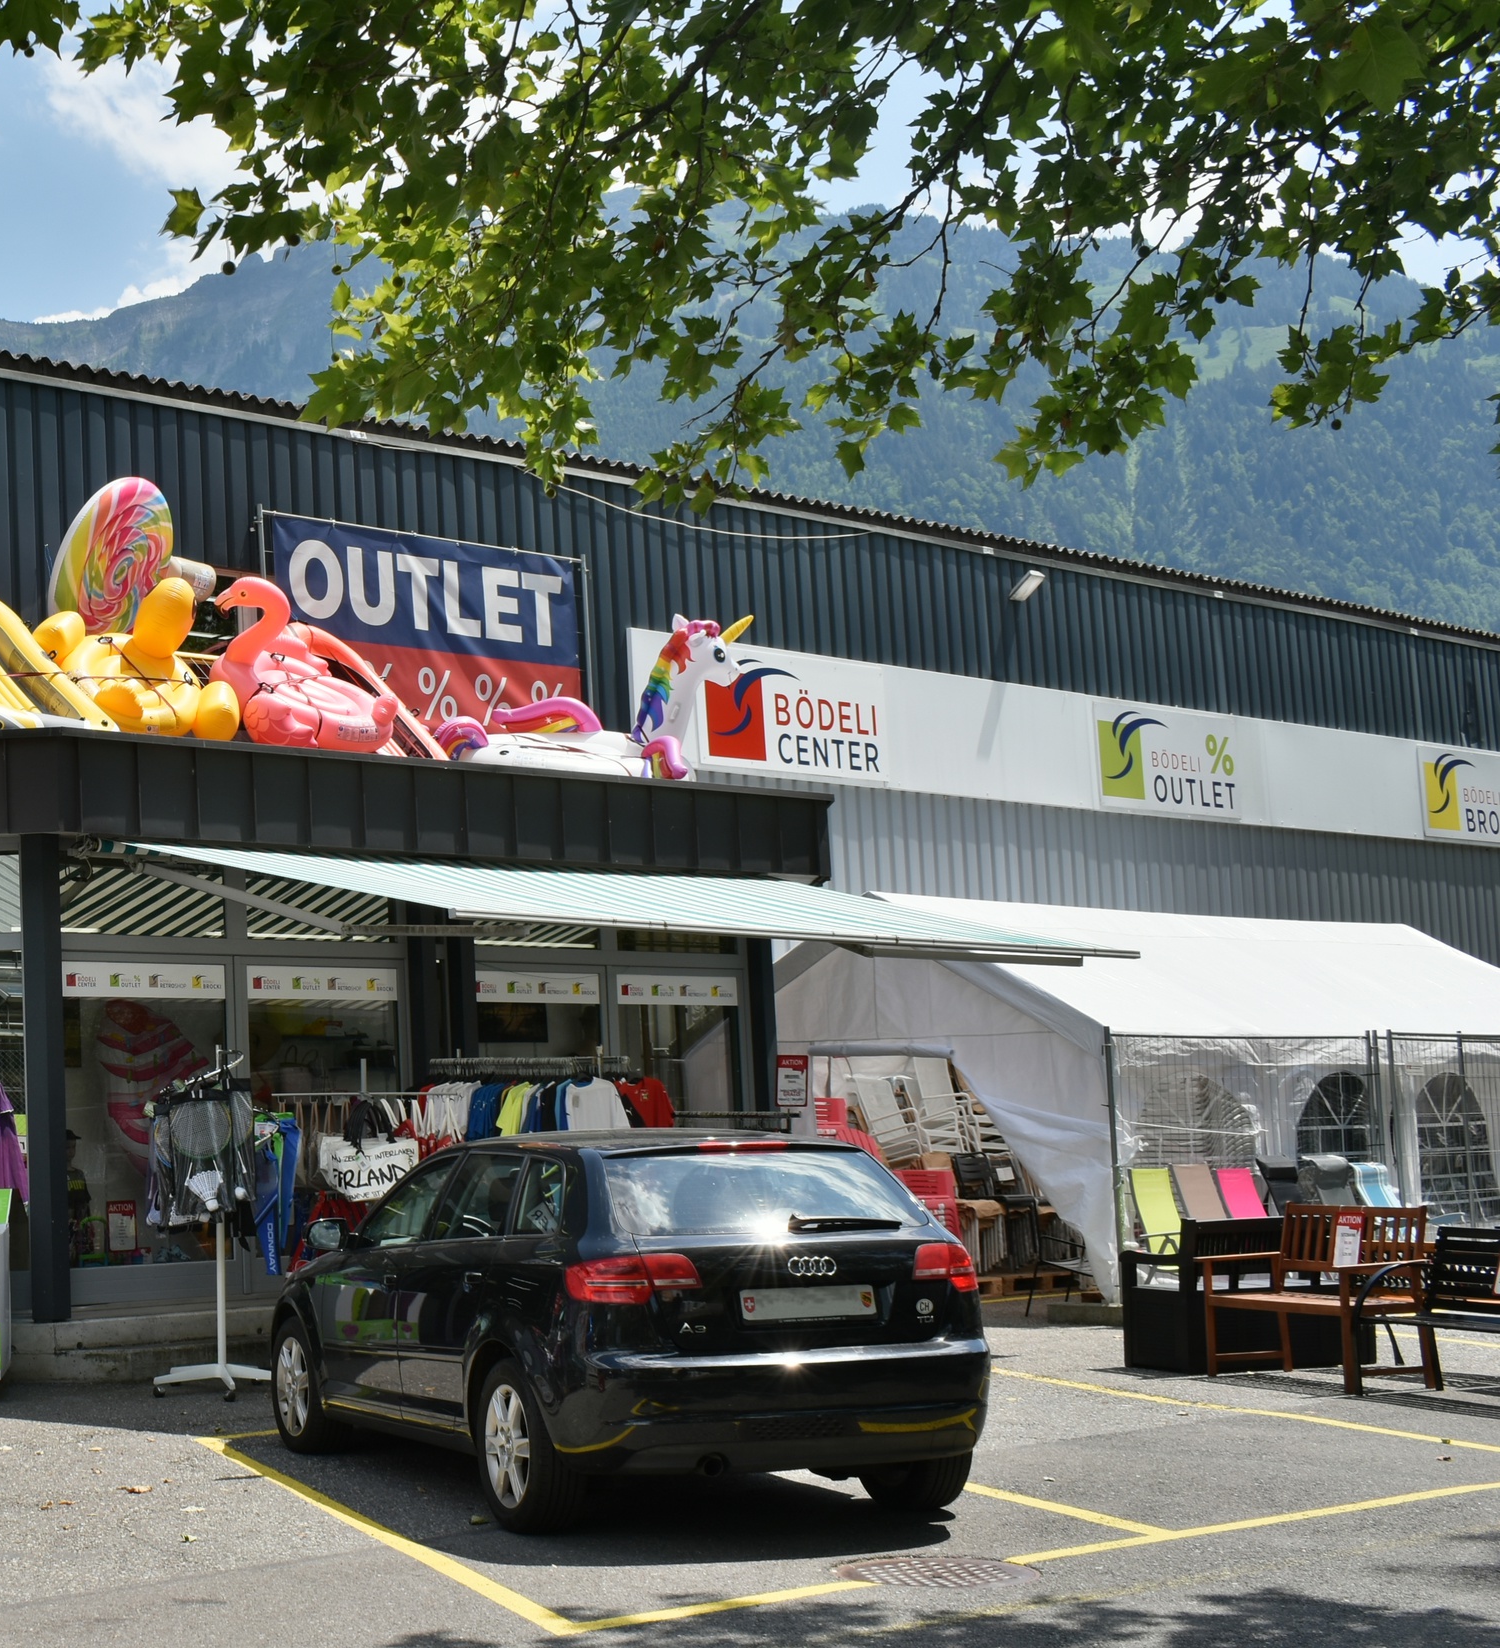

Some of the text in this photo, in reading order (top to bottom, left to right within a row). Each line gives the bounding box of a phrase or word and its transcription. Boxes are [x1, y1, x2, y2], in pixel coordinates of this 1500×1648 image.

[289, 539, 562, 647] OUTLET
[418, 666, 458, 722] %
[774, 689, 878, 737] BÖDELI
[778, 733, 881, 773] CENTER
[1151, 734, 1235, 777] BÖDELI %
[1153, 775, 1236, 811] OUTLET
[1465, 808, 1500, 835] BRO
[375, 1147, 414, 1160] INTERLAKEN
[109, 1203, 133, 1212] AKTION
[1338, 1215, 1362, 1224] AKTION
[266, 1222, 277, 1275] DONNAY
[919, 1301, 929, 1312] CH
[679, 1322, 706, 1334] A3
